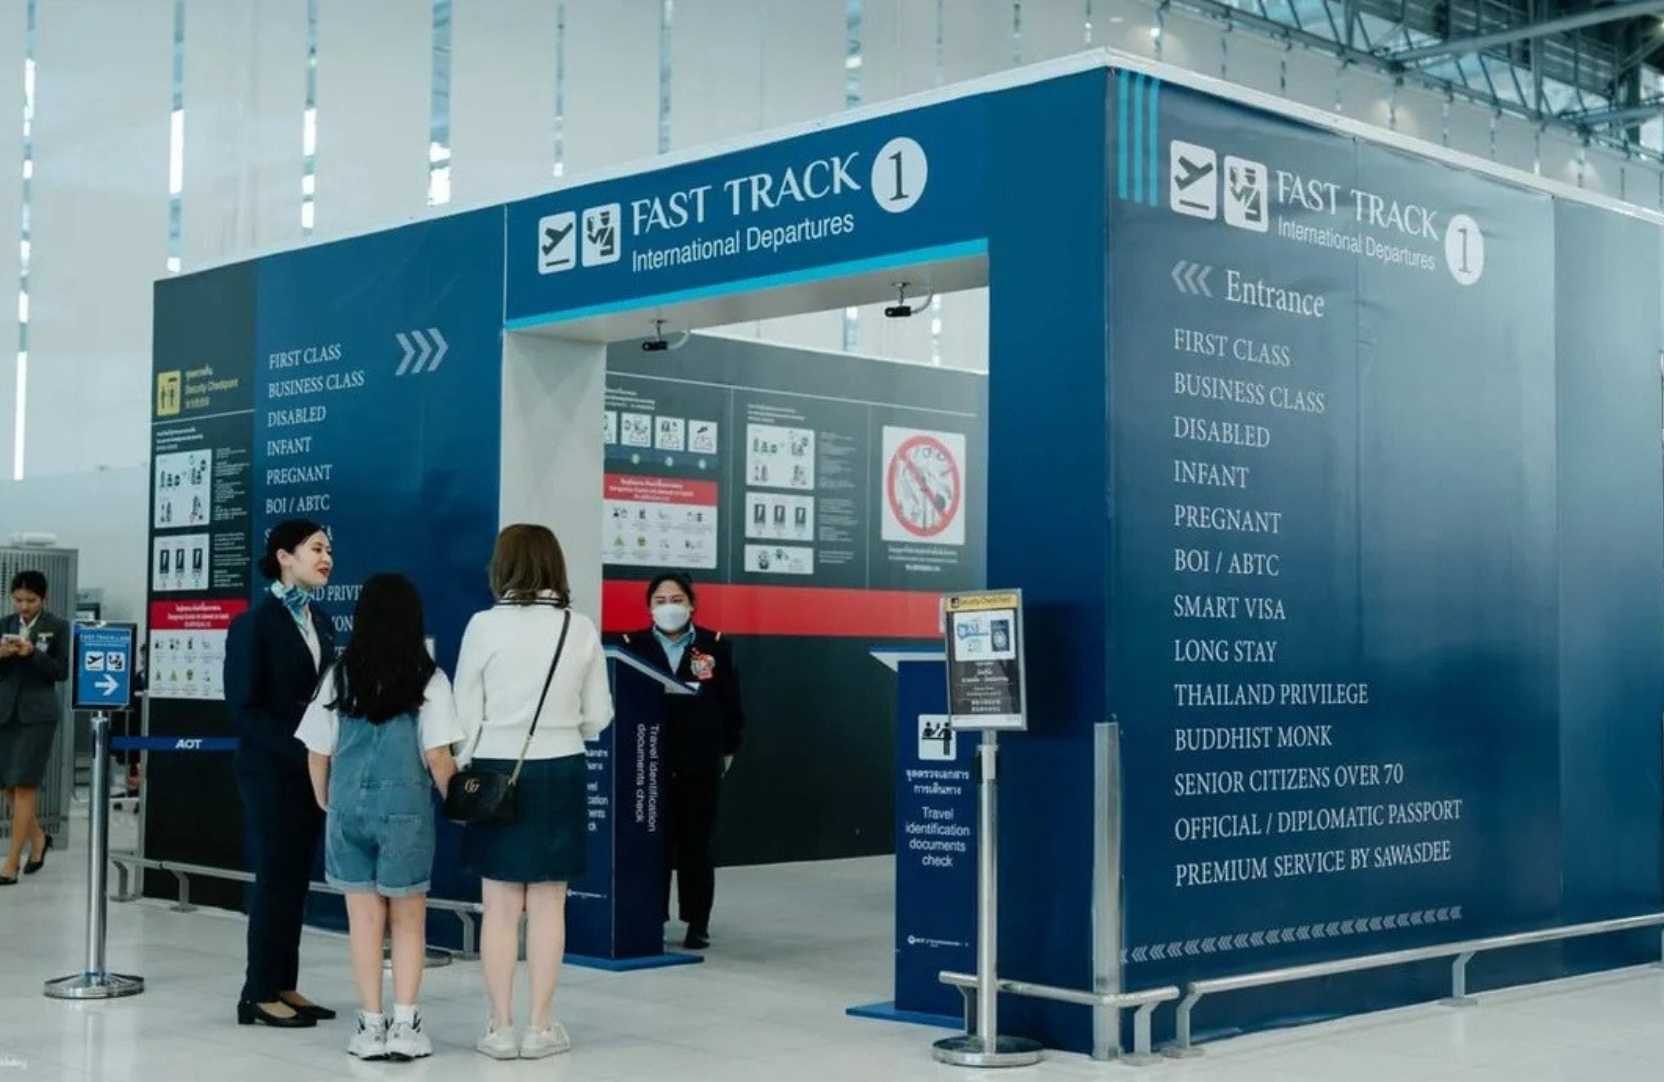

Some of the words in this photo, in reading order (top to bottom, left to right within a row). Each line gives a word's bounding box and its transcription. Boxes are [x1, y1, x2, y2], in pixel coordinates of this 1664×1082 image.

[631, 185, 712, 236] FAST
[724, 152, 861, 216] TRACK
[887, 150, 910, 202] 1
[1276, 170, 1340, 215] FAST
[1351, 189, 1439, 240] TRACK
[1457, 228, 1472, 274] 1
[632, 231, 740, 272] International
[747, 213, 854, 252] Departures
[1278, 217, 1362, 252] International
[1366, 236, 1436, 270] Departures
[1225, 269, 1324, 317] Entrance
[269, 350, 302, 369] FIRST
[304, 344, 342, 364] CLASS
[1174, 328, 1228, 357] FIRST
[1233, 338, 1291, 367] CLASS
[268, 376, 323, 398] BUSINESS
[326, 370, 365, 390] CLASS
[1174, 372, 1265, 405] BUSINESS
[1269, 386, 1326, 414] CLASS
[267, 406, 327, 427] DISABLED
[1174, 416, 1270, 447] DISABLED
[267, 437, 312, 456] INFANT
[266, 464, 333, 485] PREGNANT
[1174, 460, 1249, 488] INFANT
[266, 498, 287, 514] BOI
[289, 497, 295, 513] /
[297, 494, 330, 512] ABTC
[1174, 504, 1281, 534] PREGNANT
[1174, 549, 1210, 573] BOI
[1215, 551, 1223, 574] /
[1228, 552, 1280, 577] ABTC
[1174, 594, 1239, 619] SMART
[1244, 597, 1286, 620] VISA
[1174, 639, 1229, 662] LONG
[1234, 640, 1277, 663] STAY
[1174, 683, 1275, 707] THAILAND
[1280, 683, 1369, 705] PRIVILEGE
[175, 739, 203, 749] AOT
[649, 723, 660, 759] Travel
[1174, 726, 1273, 751] BUDDHIST
[1277, 724, 1333, 748] MONK
[636, 723, 646, 786] documents
[1174, 771, 1245, 796] SENIOR
[1250, 767, 1331, 792] CITIZENS
[1334, 764, 1379, 787] OVER
[1384, 763, 1404, 784] 70
[635, 788, 646, 823] check
[648, 762, 660, 832] identification
[922, 806, 954, 820] Travel
[1174, 814, 1261, 841] OFFICIAL
[1266, 813, 1273, 835] /
[1278, 805, 1384, 833] DIPLOMATIC
[1387, 799, 1463, 825] PASSPORT
[905, 822, 970, 836] identification
[909, 837, 966, 852] documents
[922, 853, 954, 867] check
[1175, 857, 1268, 888] PREMIUM
[1274, 849, 1345, 878] SERVICE
[1350, 848, 1371, 870] BY
[1374, 840, 1451, 868] SAWASDEE
